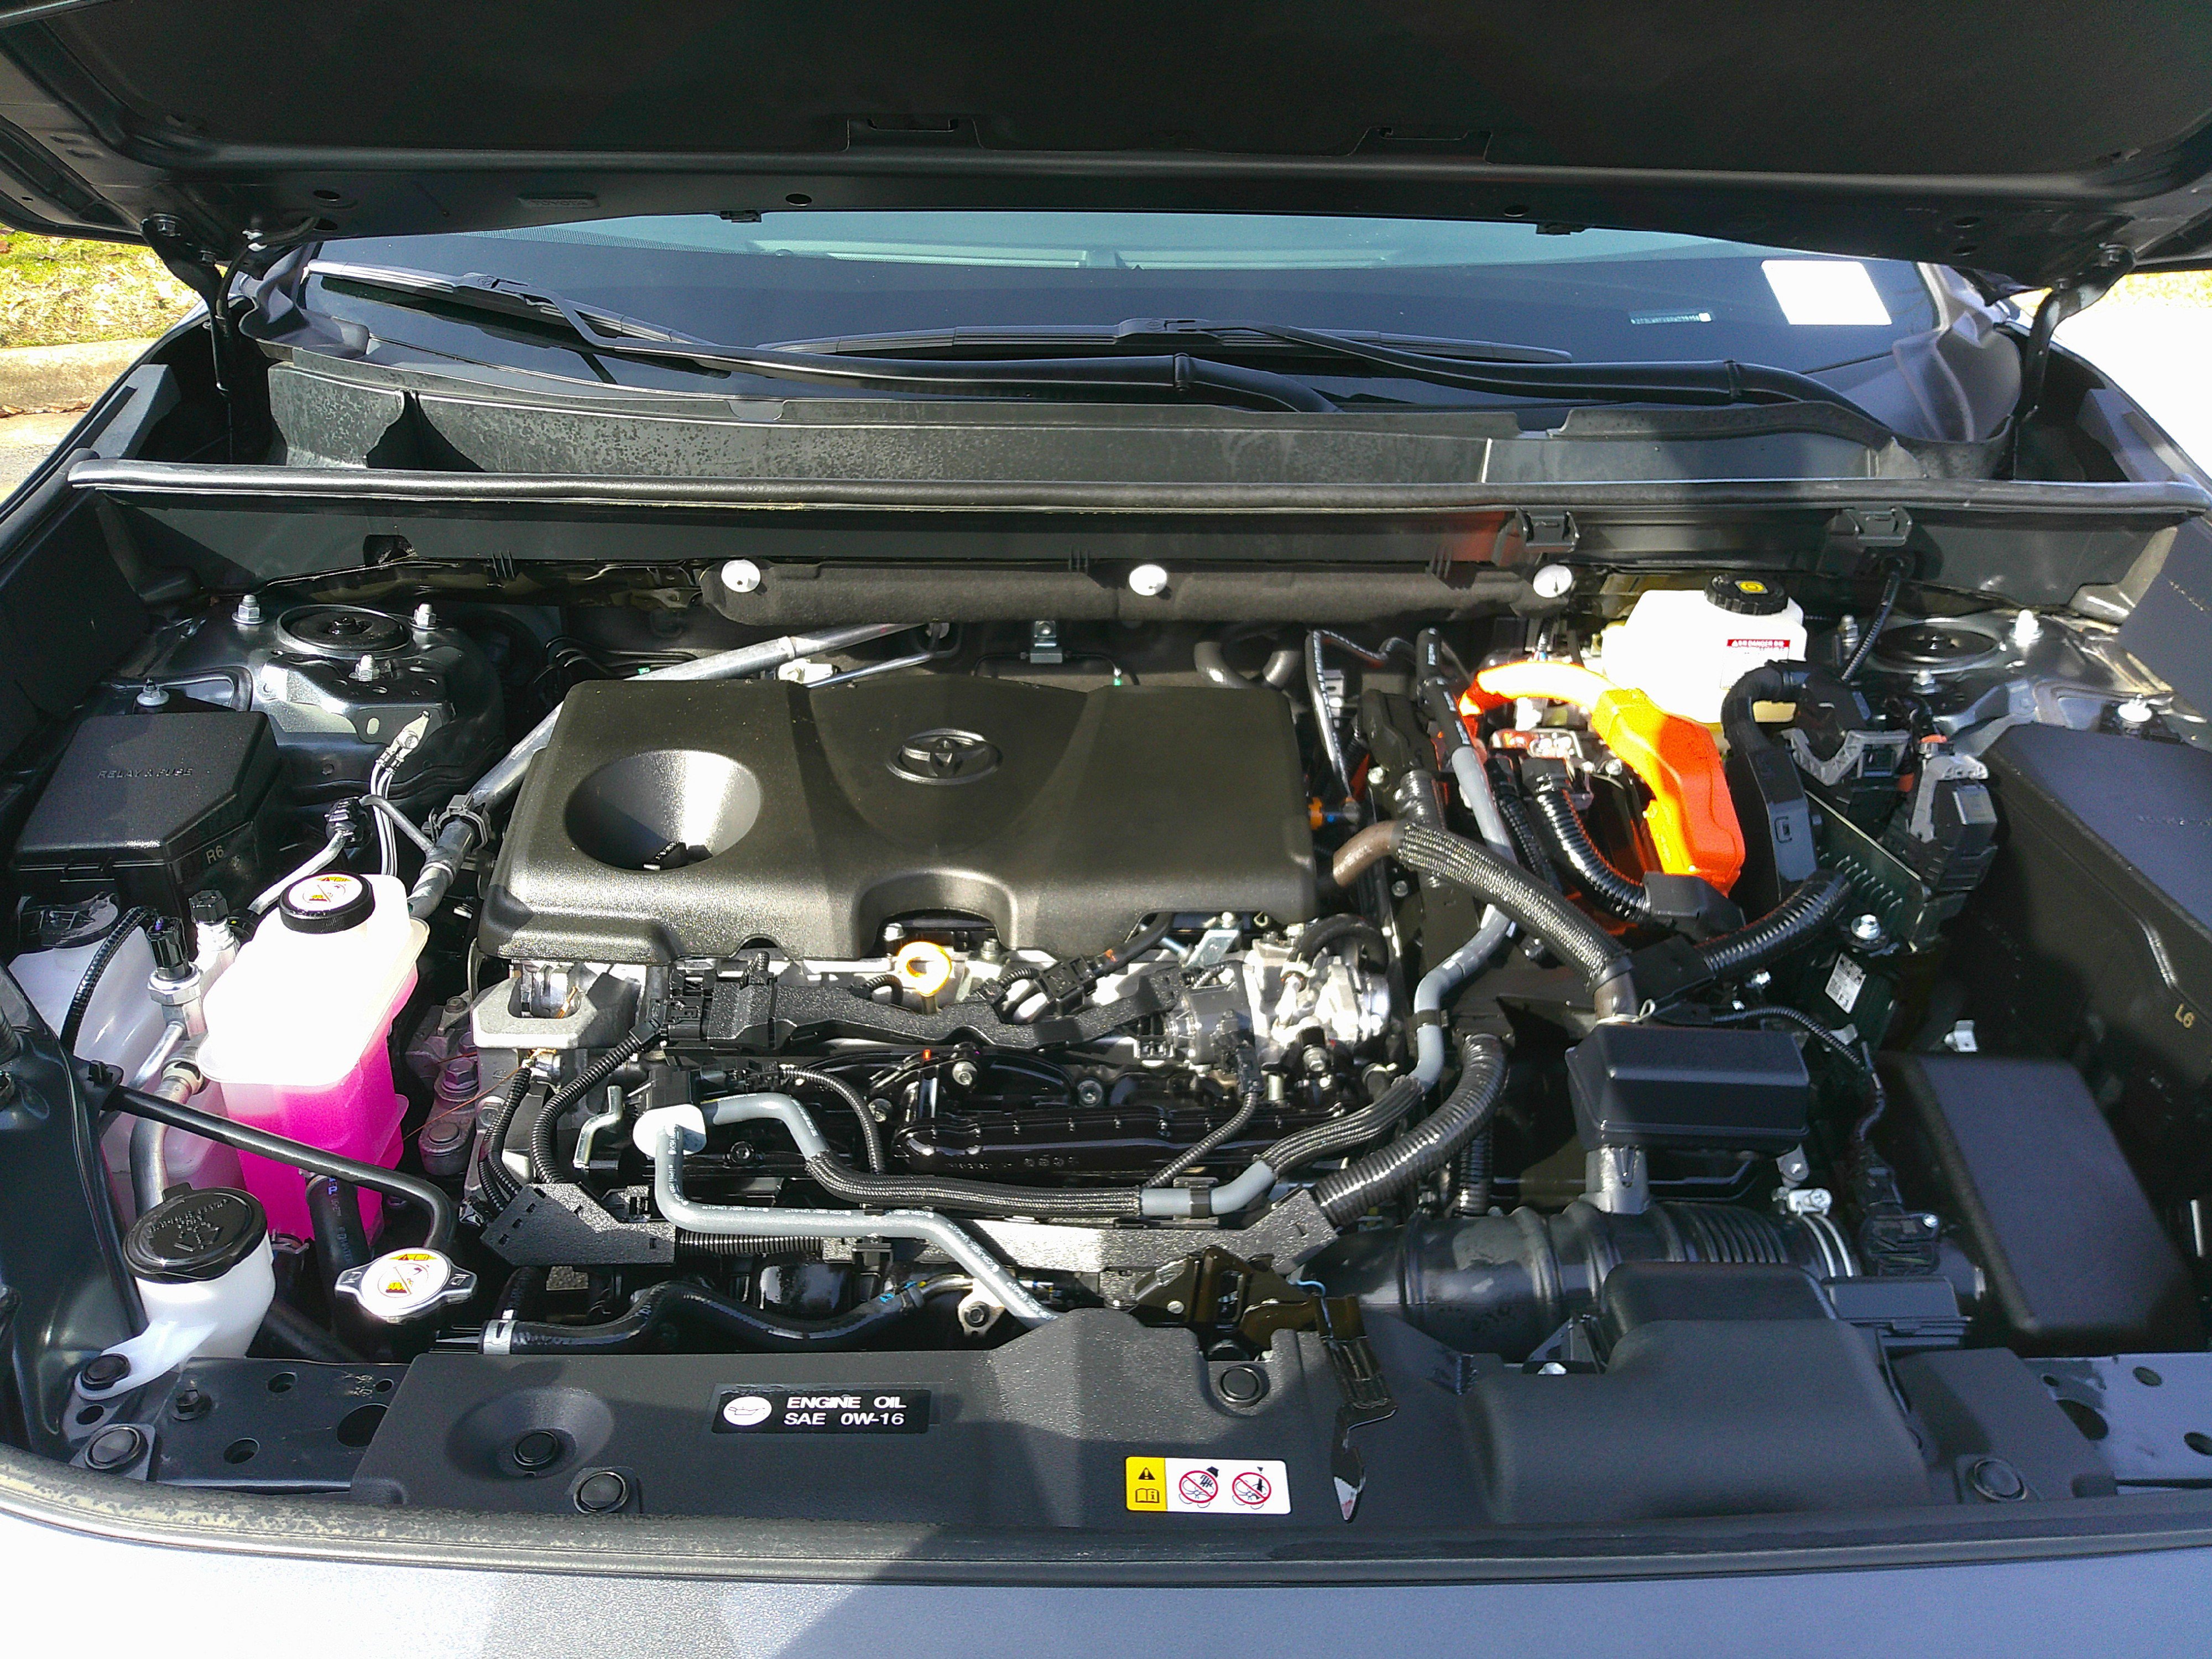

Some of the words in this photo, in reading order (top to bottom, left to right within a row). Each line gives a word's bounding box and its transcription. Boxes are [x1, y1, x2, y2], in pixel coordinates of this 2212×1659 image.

[97, 769, 143, 779] RELAY
[156, 768, 194, 777] FUSE
[205, 845, 225, 864] R6
[2174, 1003, 2195, 1029] L6
[786, 1396, 861, 1409] ENGINE
[873, 1396, 907, 1408] OIL
[783, 1412, 827, 1426] SAE
[839, 1412, 905, 1426] 0W-16
